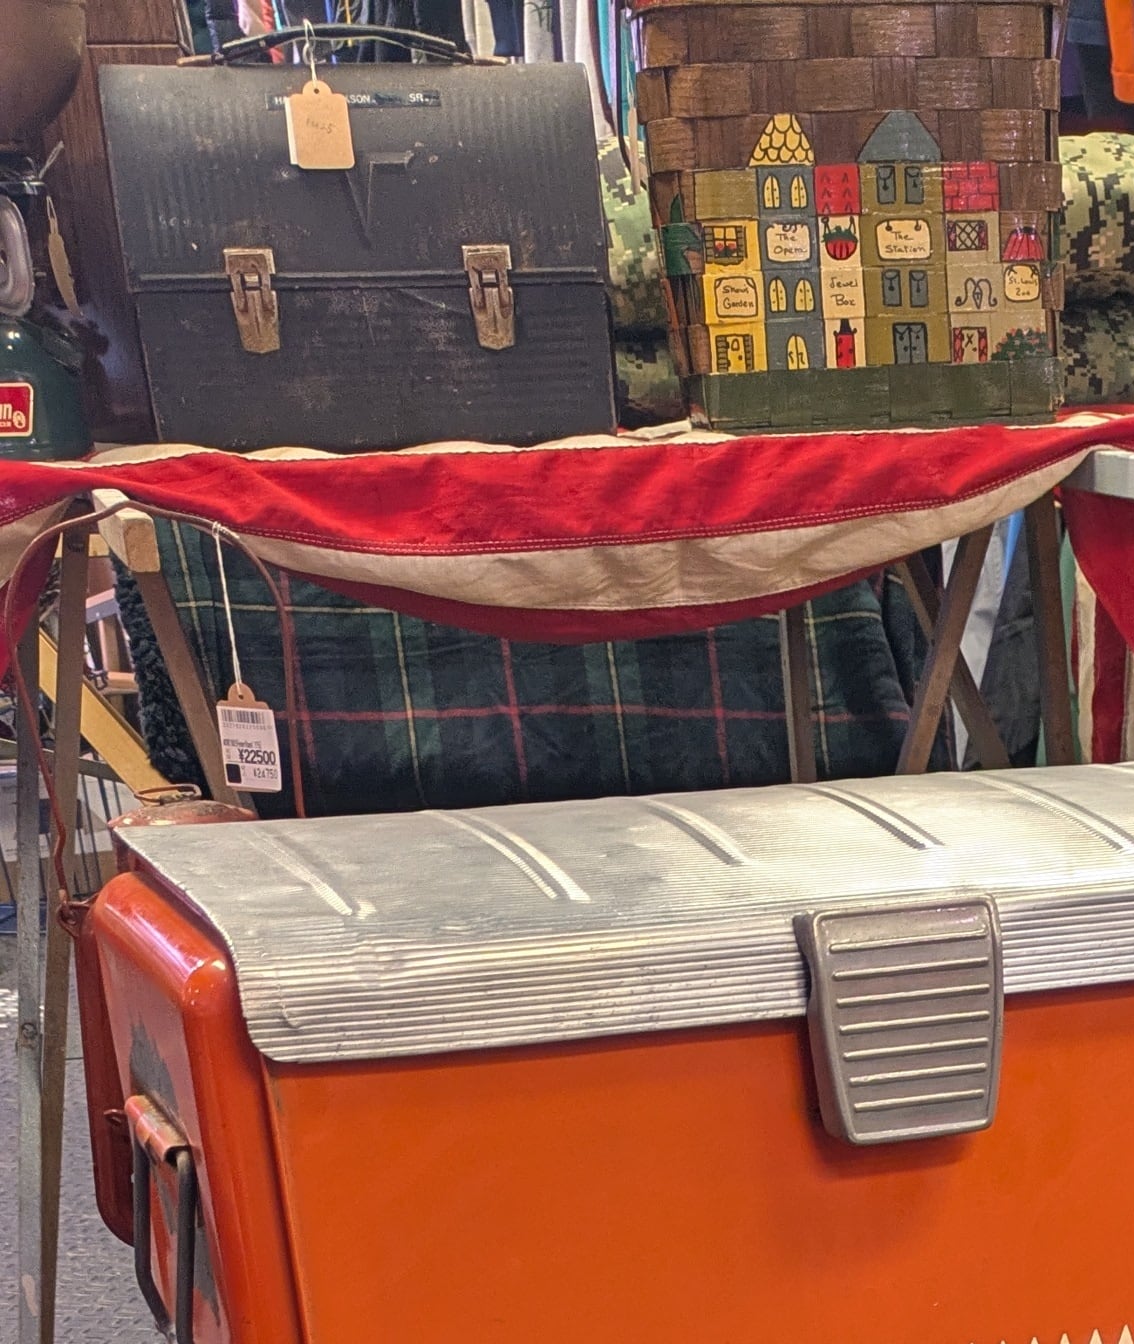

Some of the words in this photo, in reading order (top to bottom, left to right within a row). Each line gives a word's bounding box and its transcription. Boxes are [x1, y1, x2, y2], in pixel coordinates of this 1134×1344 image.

[775, 233, 798, 242] The
[891, 231, 914, 241] The
[885, 244, 926, 254] Station
[829, 277, 859, 289] Jewel
[830, 294, 857, 307] Box
[237, 748, 276, 766] ¥22500
